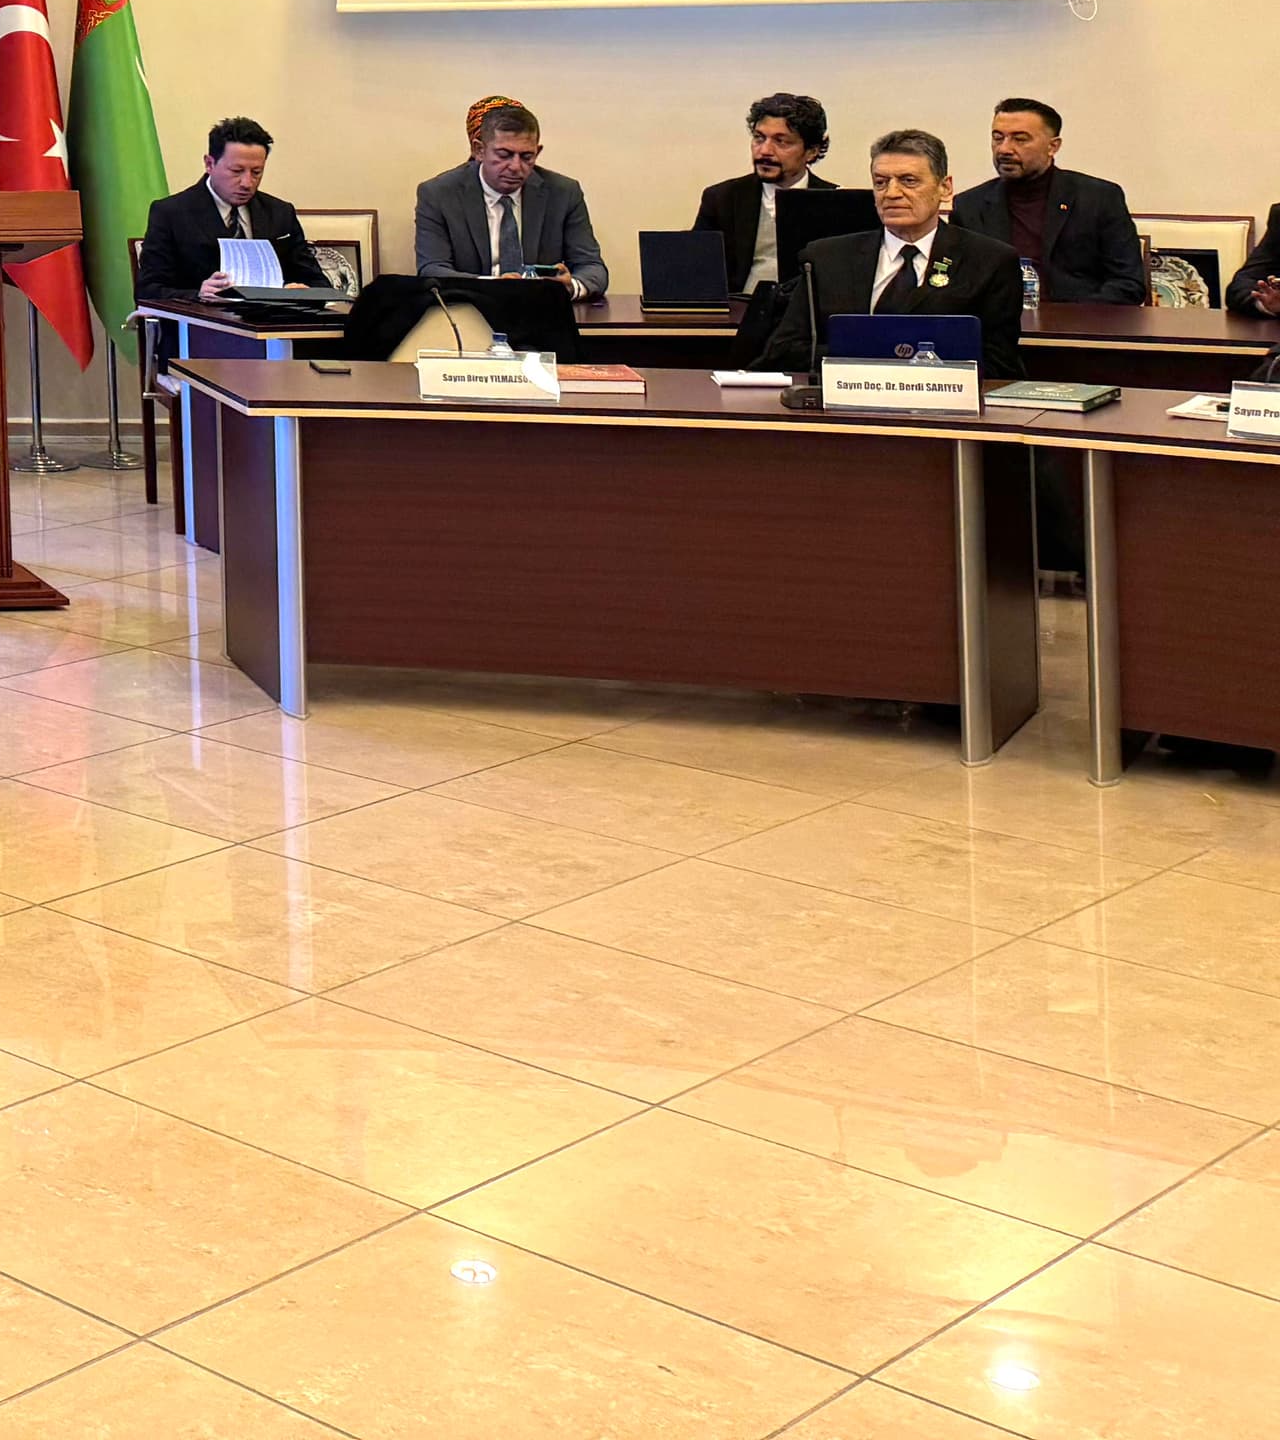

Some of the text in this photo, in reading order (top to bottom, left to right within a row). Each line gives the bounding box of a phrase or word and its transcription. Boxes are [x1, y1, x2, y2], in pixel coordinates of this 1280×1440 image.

[442, 373, 466, 383] Sayın
[489, 374, 533, 384] YILMAZSO
[836, 380, 863, 392] Sayın
[864, 381, 884, 393] Doç.
[885, 381, 898, 392] Dr.
[925, 382, 964, 393] SARIYEV
[1234, 406, 1262, 418] Sayın
